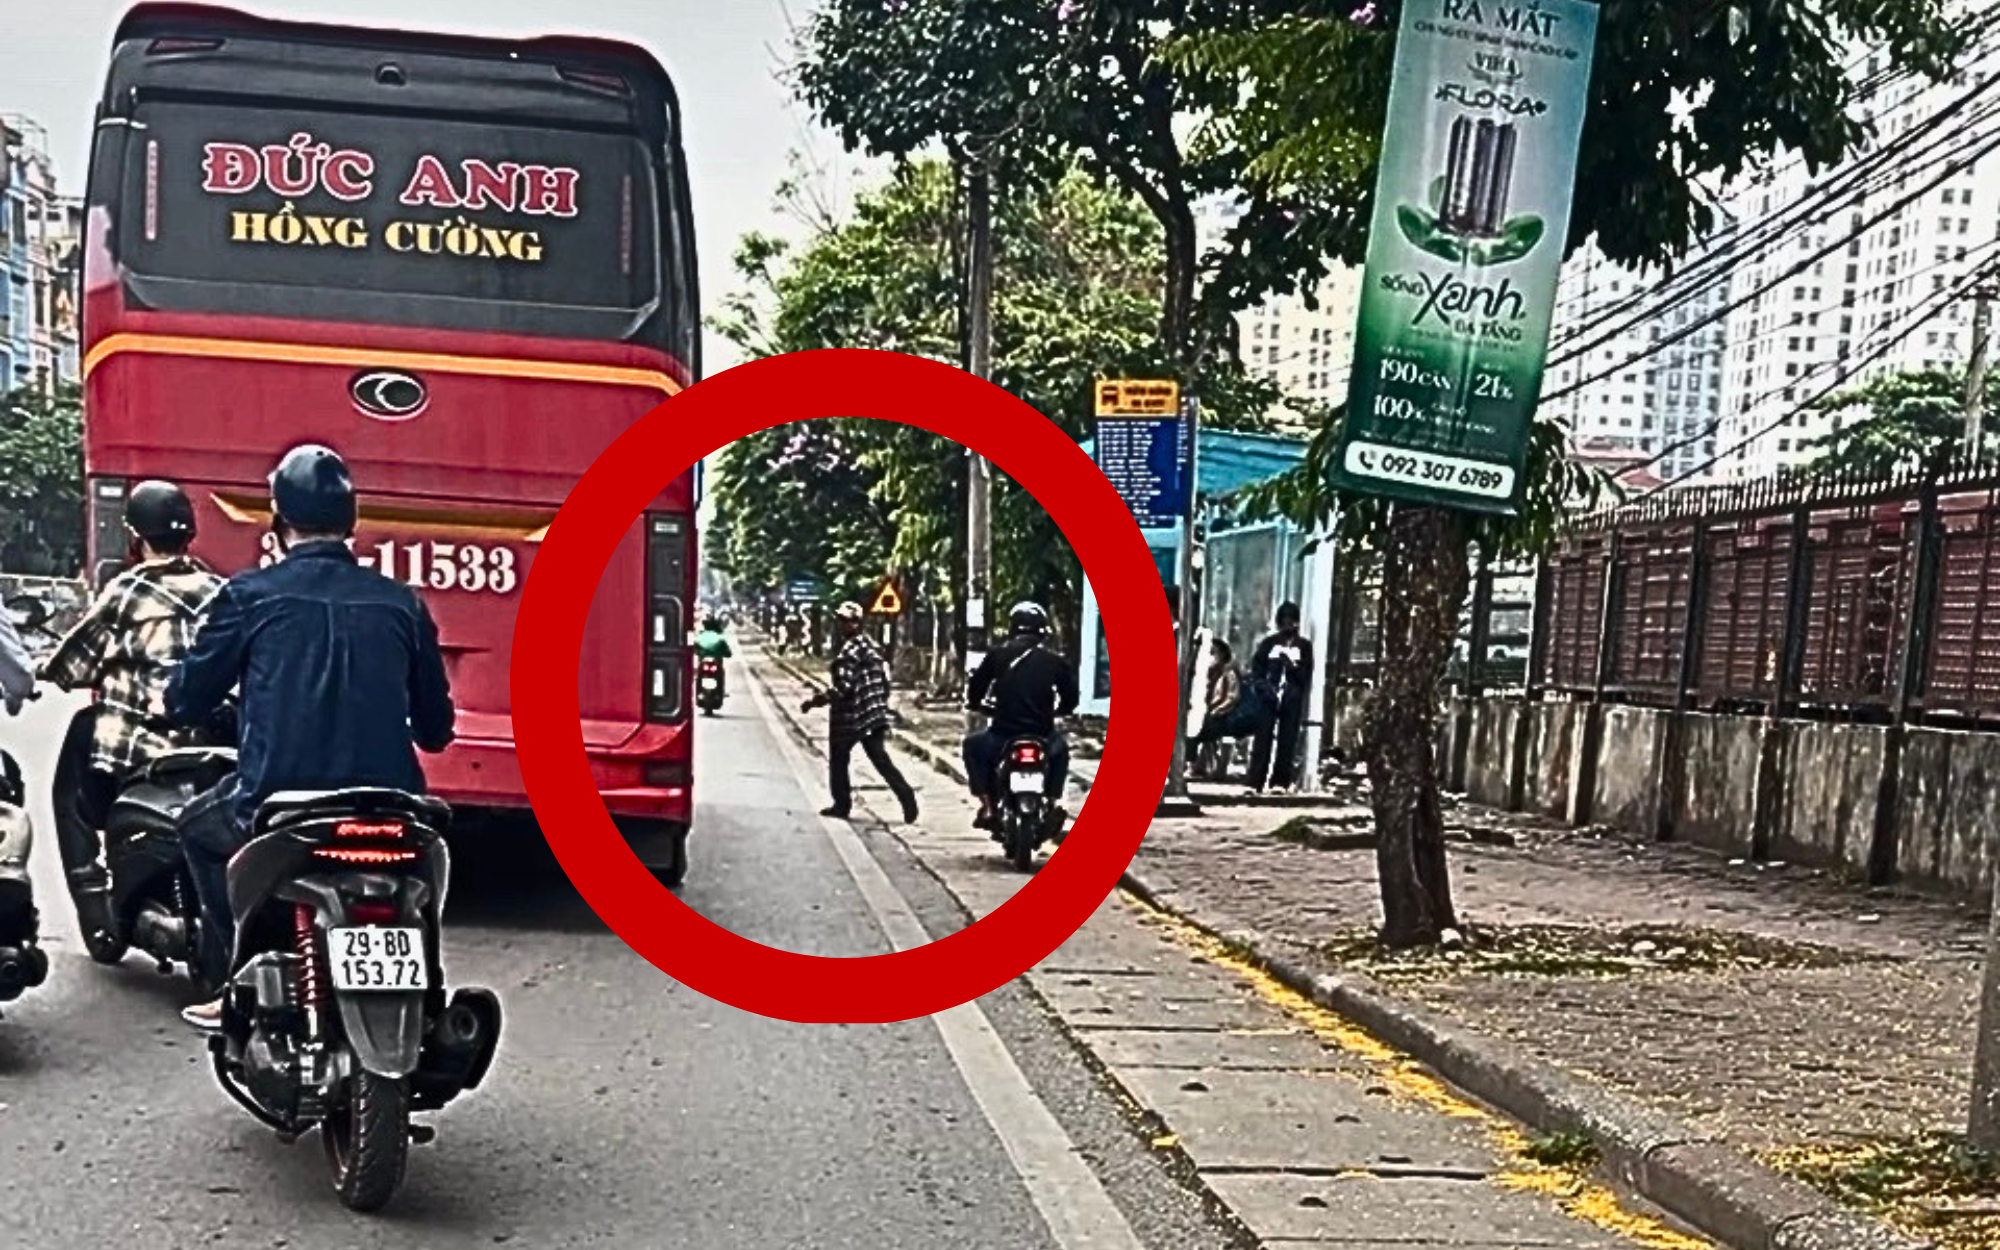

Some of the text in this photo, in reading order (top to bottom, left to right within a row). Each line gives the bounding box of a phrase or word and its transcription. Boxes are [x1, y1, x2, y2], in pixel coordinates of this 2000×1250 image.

[1443, 0, 1482, 24] RA
[1496, 0, 1560, 37] MẮT
[1443, 83, 1536, 117] FLORA
[202, 132, 579, 217] ĐỨC ANH
[230, 201, 544, 262] HỒNG CƯỜNG
[1381, 453, 1503, 489] 092 307 6789
[341, 959, 422, 987] 153.72
